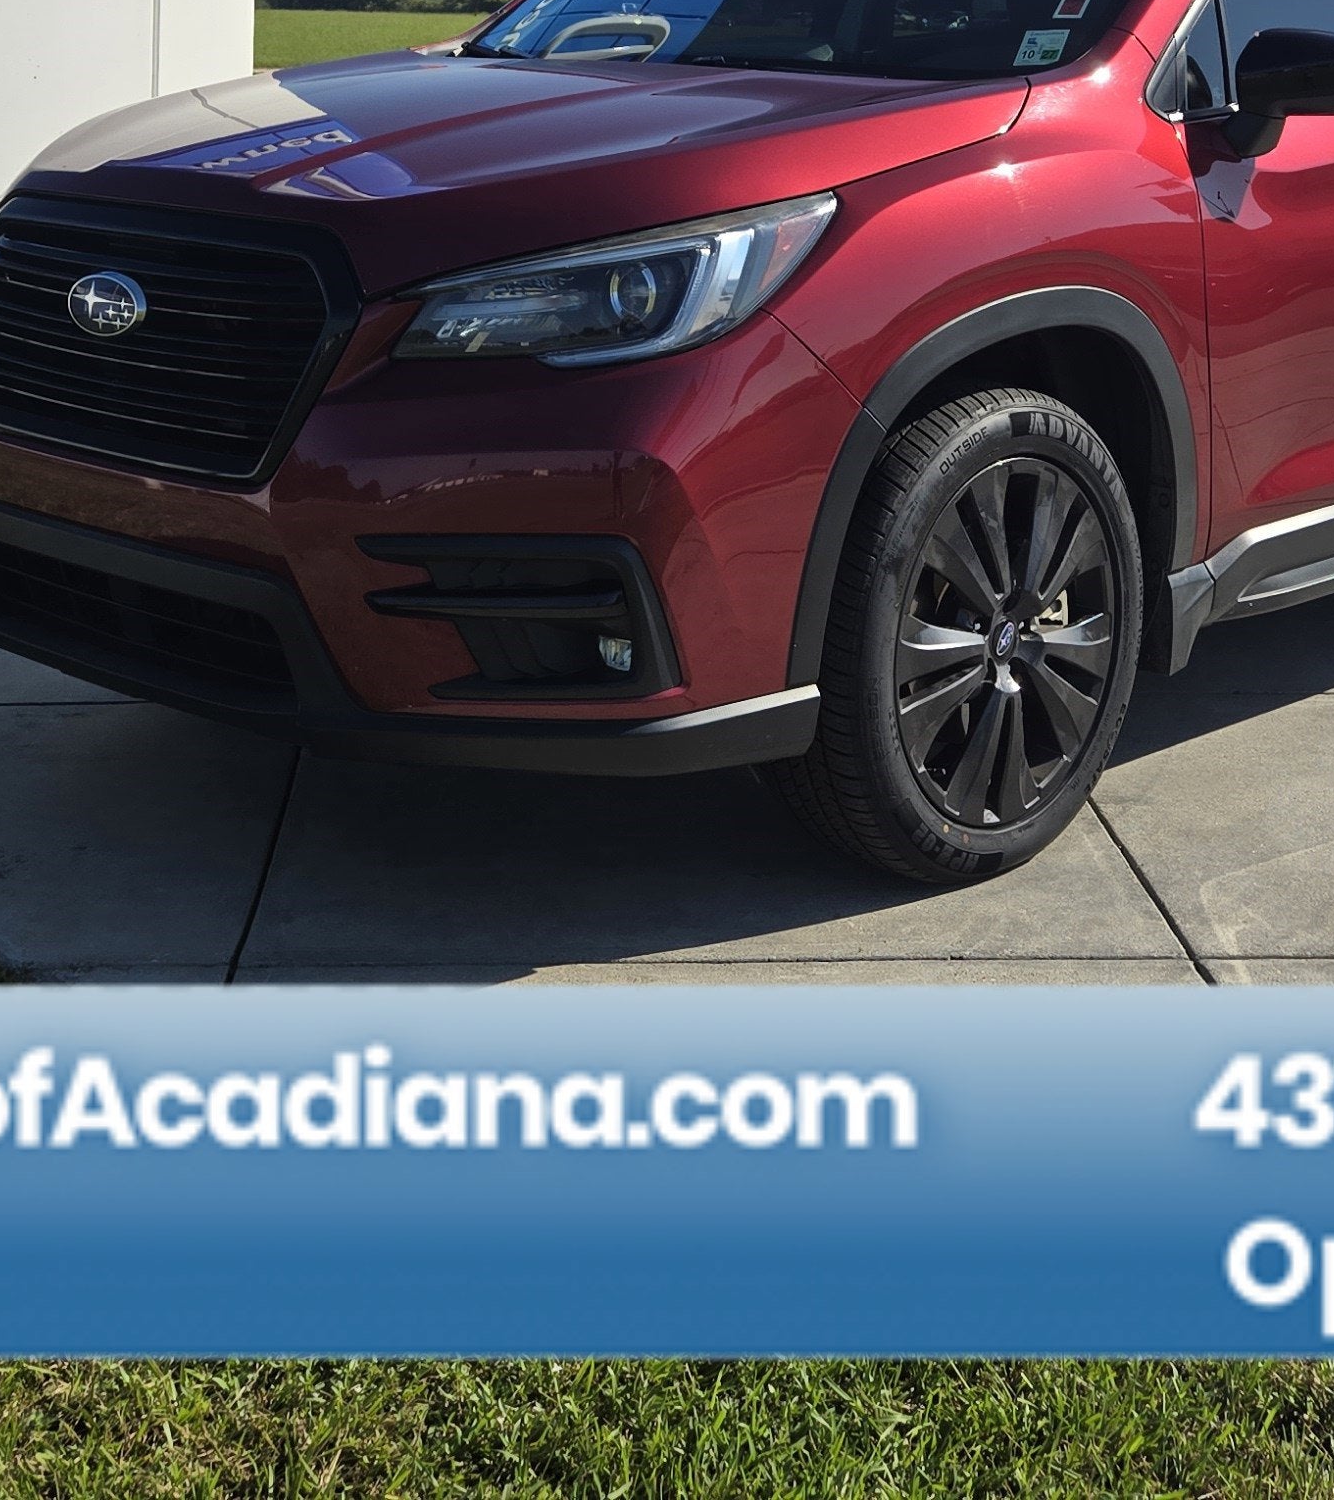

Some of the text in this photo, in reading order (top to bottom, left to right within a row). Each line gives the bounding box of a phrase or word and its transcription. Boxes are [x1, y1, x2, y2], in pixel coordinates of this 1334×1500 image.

[1021, 49, 1035, 60] 10
[938, 425, 990, 476] OUTSIDE
[1028, 412, 1124, 502] ADVANTA
